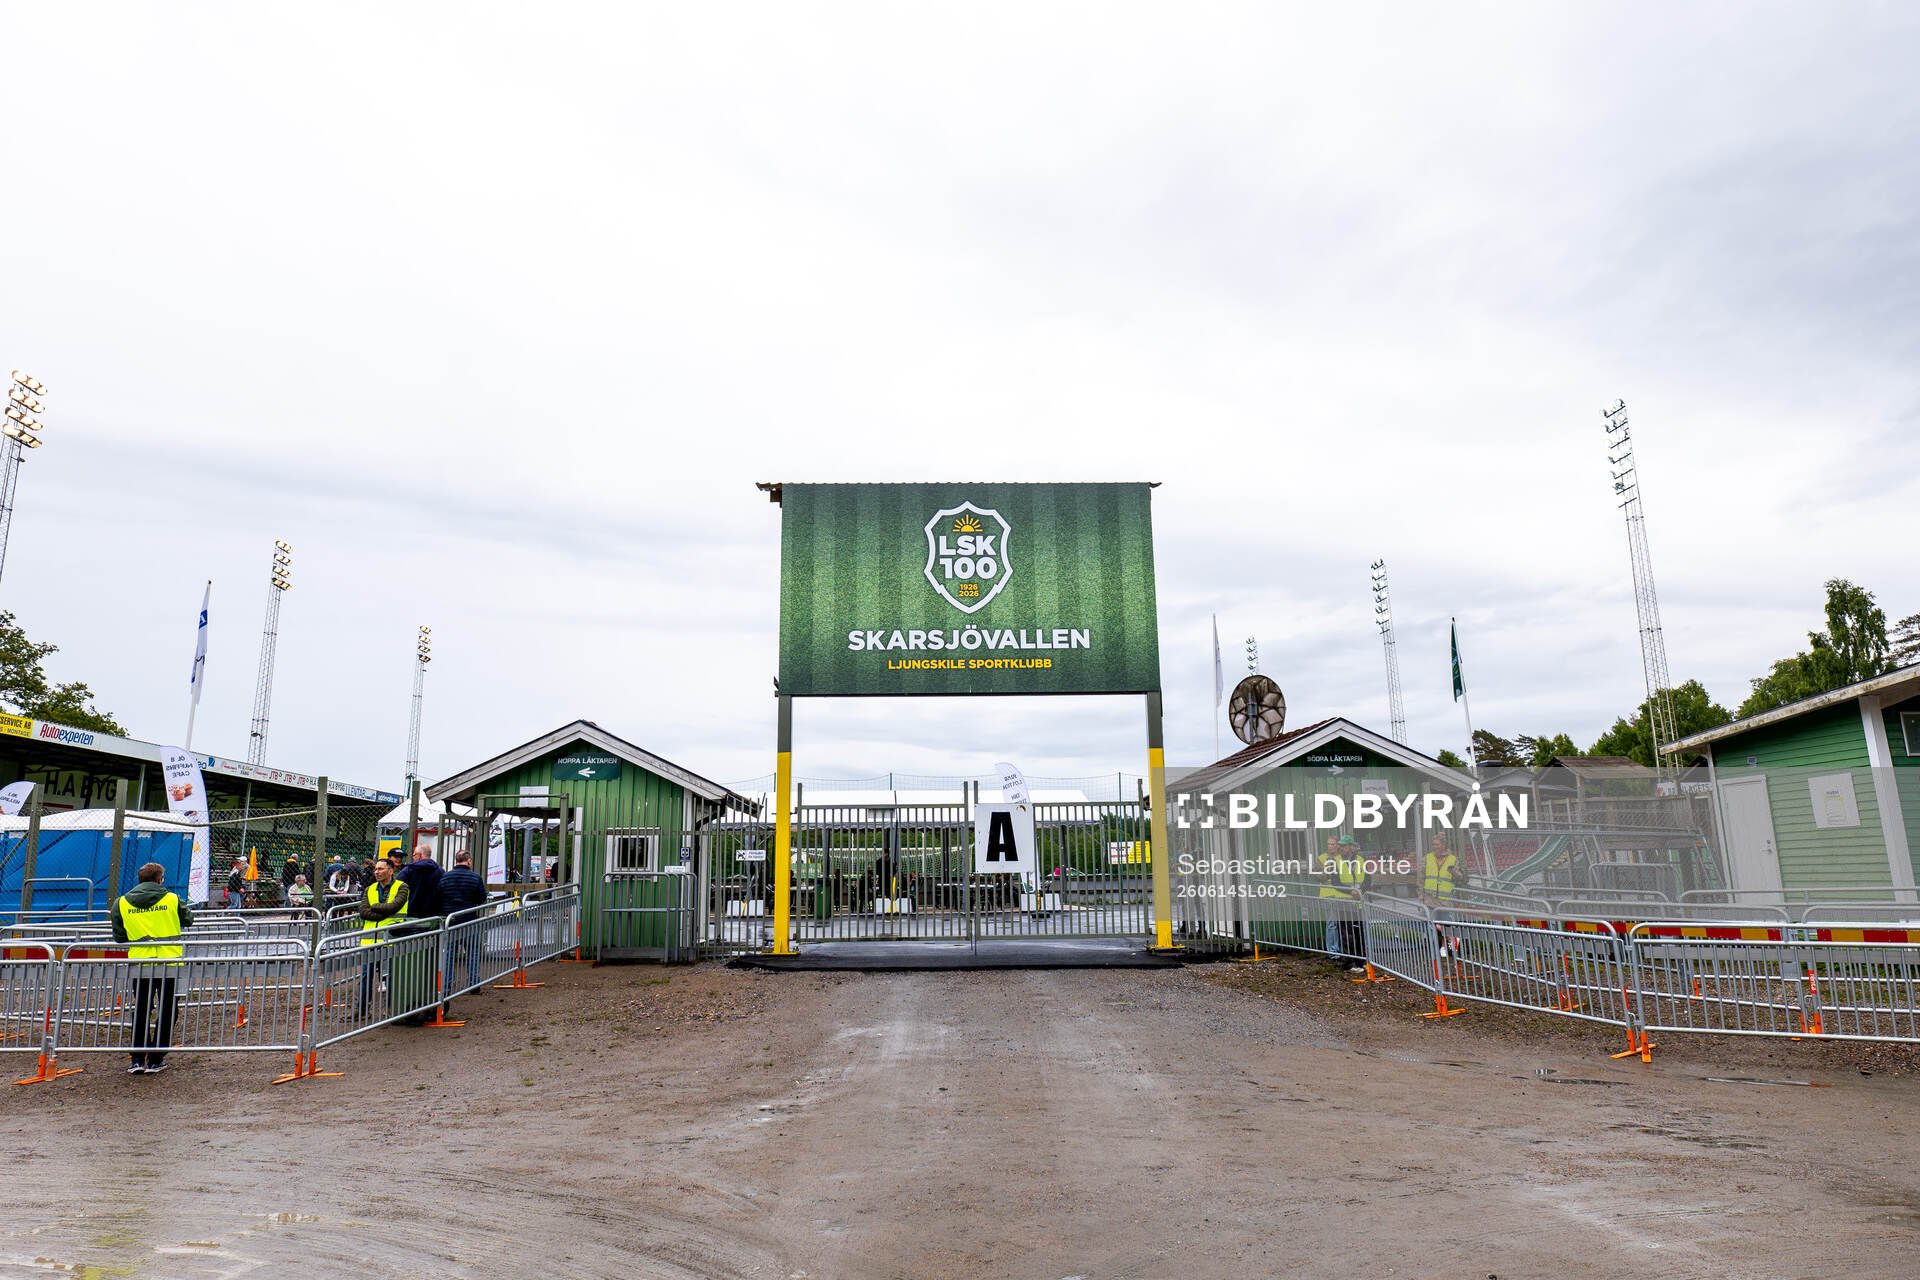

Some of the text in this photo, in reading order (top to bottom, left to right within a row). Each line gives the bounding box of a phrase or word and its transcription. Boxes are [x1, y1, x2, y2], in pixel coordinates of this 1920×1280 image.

[939, 535, 996, 556] LSK
[940, 557, 997, 579] 100
[848, 624, 1090, 650] SKARSJÖVALLEN
[888, 658, 1052, 669] LJUNGSKILE SPORTKLUBB
[40, 723, 94, 745] Autoexperten
[582, 756, 618, 764] LÄKTAREN
[986, 811, 1018, 862] A
